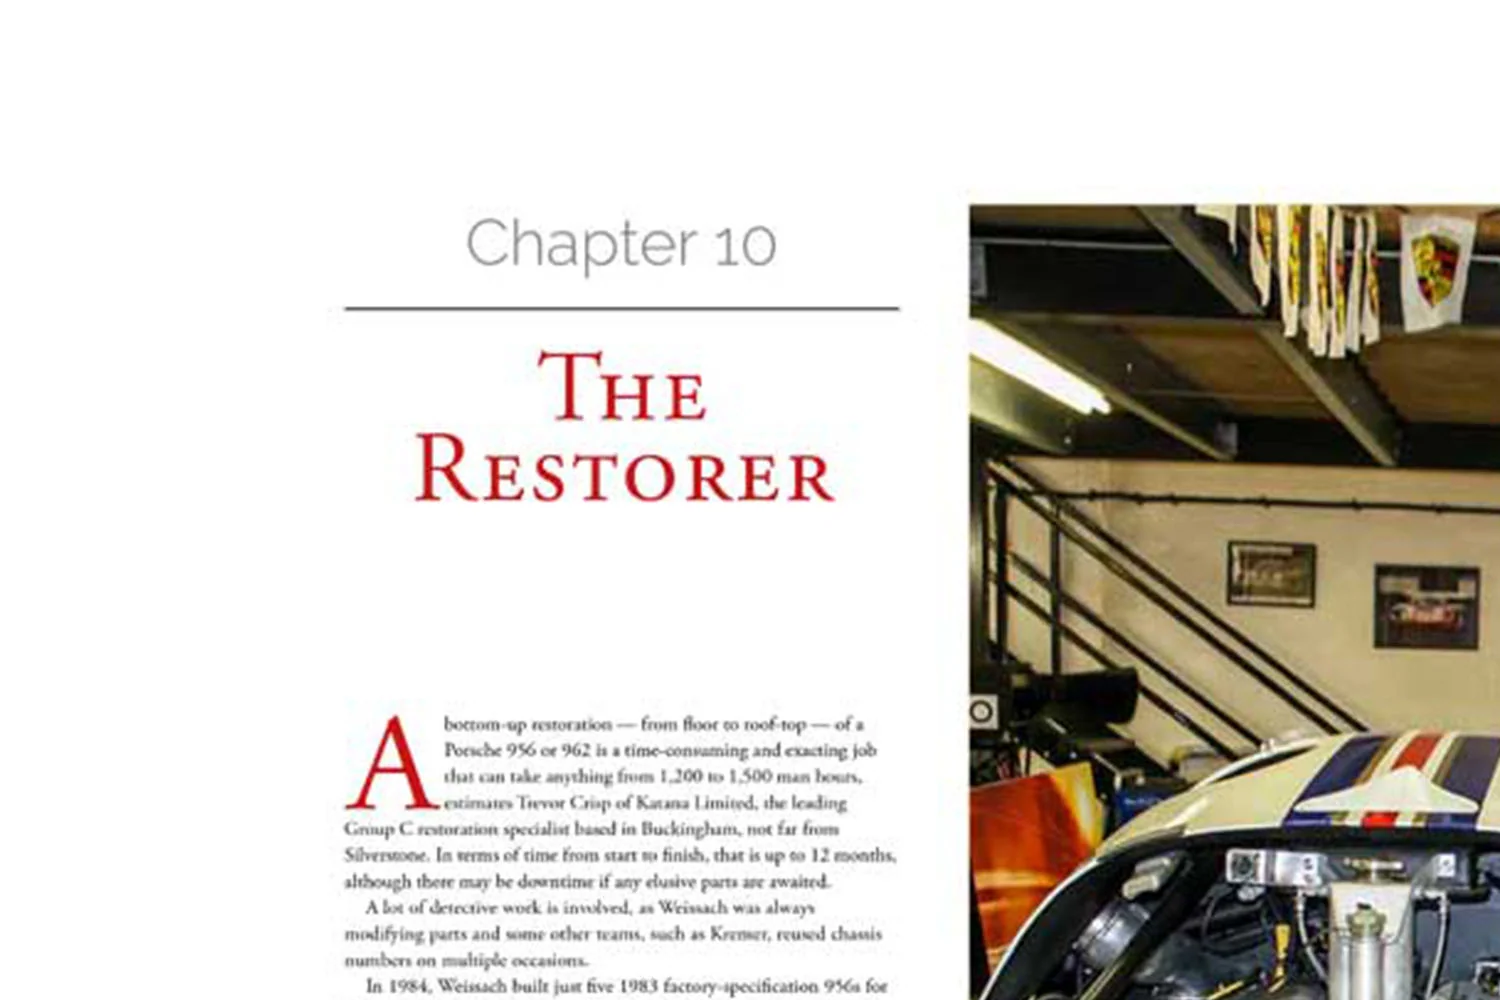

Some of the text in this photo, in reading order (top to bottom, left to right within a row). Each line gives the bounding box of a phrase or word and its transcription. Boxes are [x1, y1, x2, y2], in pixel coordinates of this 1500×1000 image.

[466, 217, 777, 280] Chapter 10
[536, 348, 708, 423] THE
[413, 431, 837, 504] RESTORER
[343, 713, 441, 812] A
[444, 740, 503, 759] Porsche
[506, 741, 537, 758] 956
[540, 745, 558, 758] or
[561, 741, 591, 759] 962
[595, 743, 608, 758] is
[624, 742, 749, 763] time-consuming
[752, 740, 782, 759] and
[784, 742, 848, 764] exacting
[852, 741, 878, 761] job
[444, 766, 474, 785] that
[478, 772, 506, 785] can
[509, 767, 542, 784] take
[545, 766, 614, 789] anything
[617, 767, 655, 785] from
[661, 767, 704, 785] 1,200
[707, 771, 725, 784] to
[730, 767, 774, 785] 1,500
[776, 772, 811, 785] man
[343, 821, 396, 842] Group
[417, 824, 499, 837] restoration
[503, 819, 570, 842] specialist
[574, 819, 617, 838] based
[621, 824, 637, 837] in
[641, 819, 742, 842] Buckingham,
[747, 824, 773, 837] not
[777, 818, 797, 837] far
[802, 820, 840, 837] from
[345, 872, 412, 895] although
[416, 872, 455, 890] there
[458, 877, 492, 894] may
[495, 872, 514, 890] be
[517, 872, 594, 890] downtime
[598, 872, 611, 890] if
[614, 877, 643, 894] any
[645, 872, 697, 890] elusive
[700, 876, 739, 895] parts
[742, 877, 765, 890] are
[366, 976, 383, 995] In
[437, 976, 508, 995] Weissach
[511, 977, 549, 995] built
[554, 980, 582, 997] just
[586, 976, 614, 995] five
[621, 978, 659, 995] 1983
[663, 976, 819, 1000] factory-specification
[823, 978, 861, 994] 956s
[865, 976, 888, 995] for
